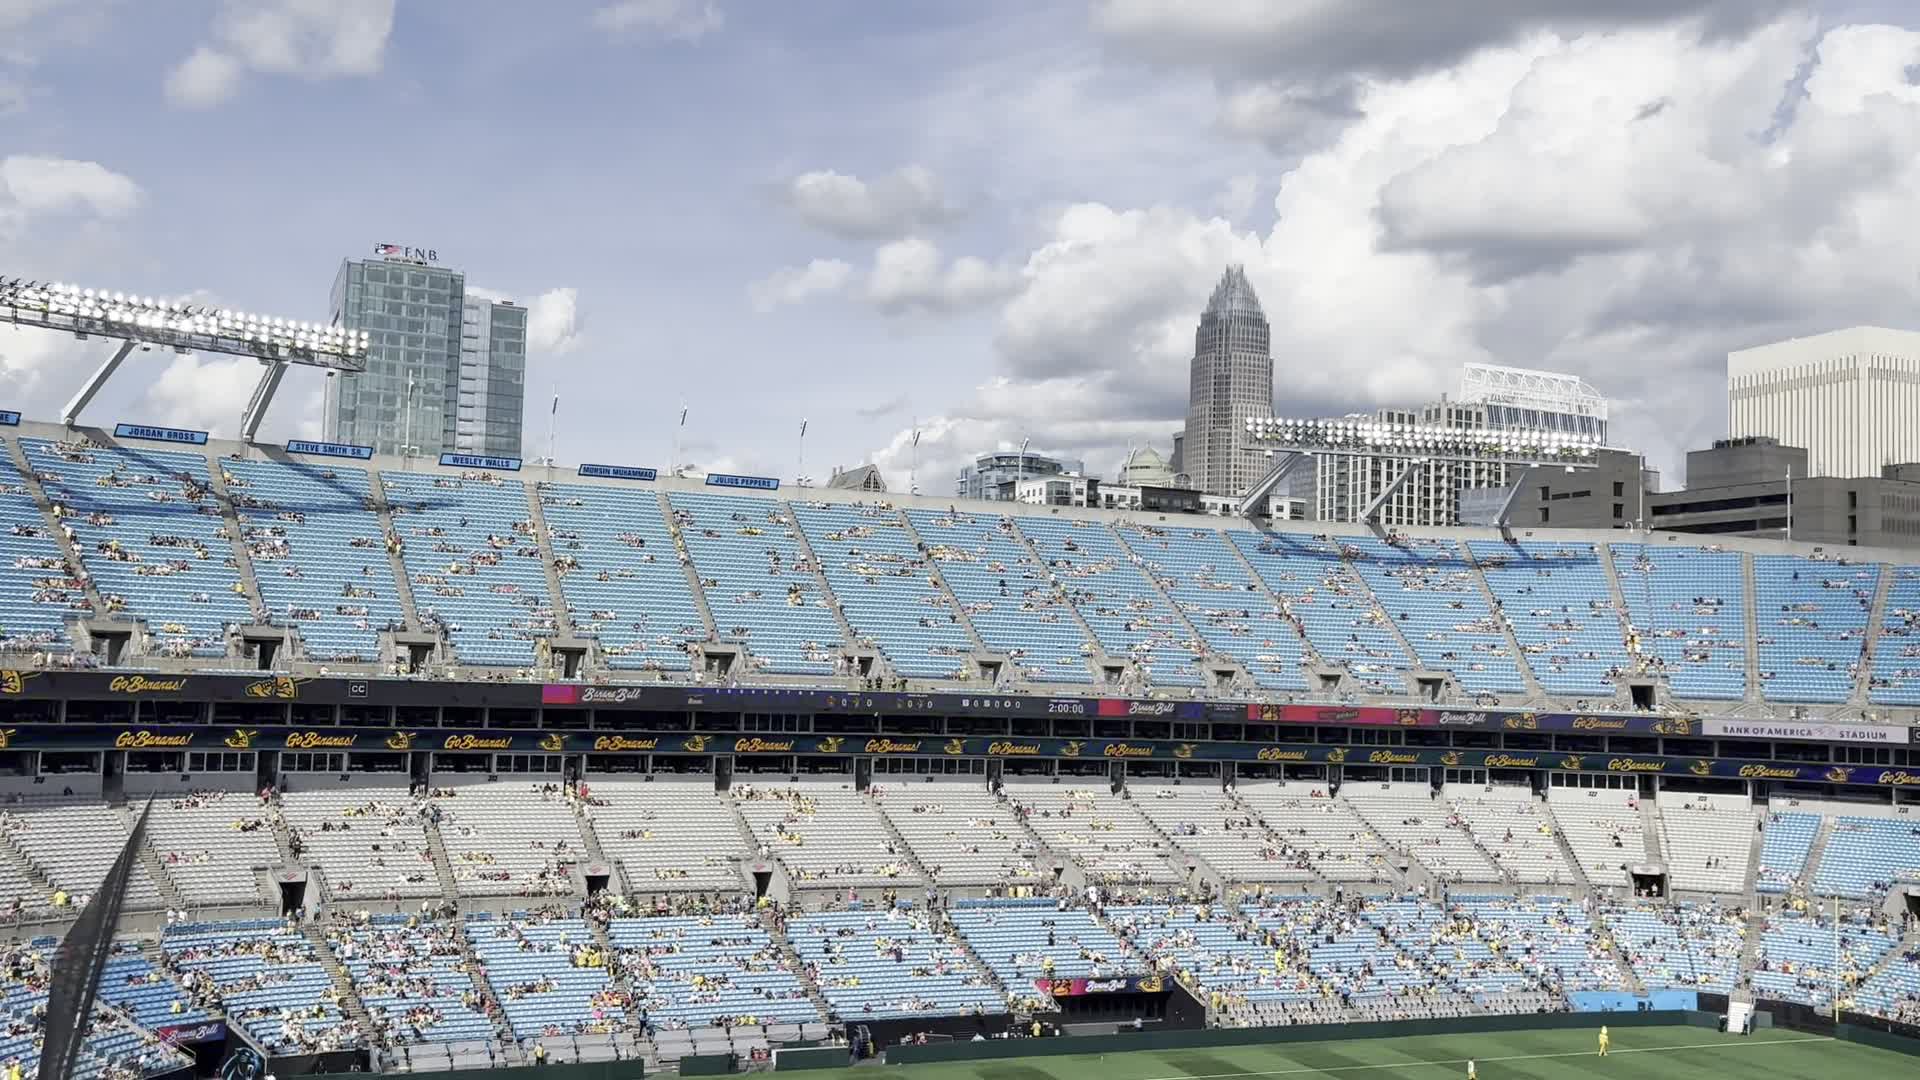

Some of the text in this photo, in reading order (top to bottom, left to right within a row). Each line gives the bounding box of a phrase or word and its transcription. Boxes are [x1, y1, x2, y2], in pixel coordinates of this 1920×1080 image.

[128, 427, 196, 441] JORDAN GROSS
[295, 443, 319, 452] STEVE
[322, 445, 347, 454] SMITH
[452, 456, 511, 468] WESLEY WALLS
[715, 475, 771, 487] JULIUS PEPPERS
[351, 685, 365, 693] CC
[1048, 703, 1084, 713] 2:00:00
[1722, 726, 1887, 740] BANK OF AMERICA STADIUM
